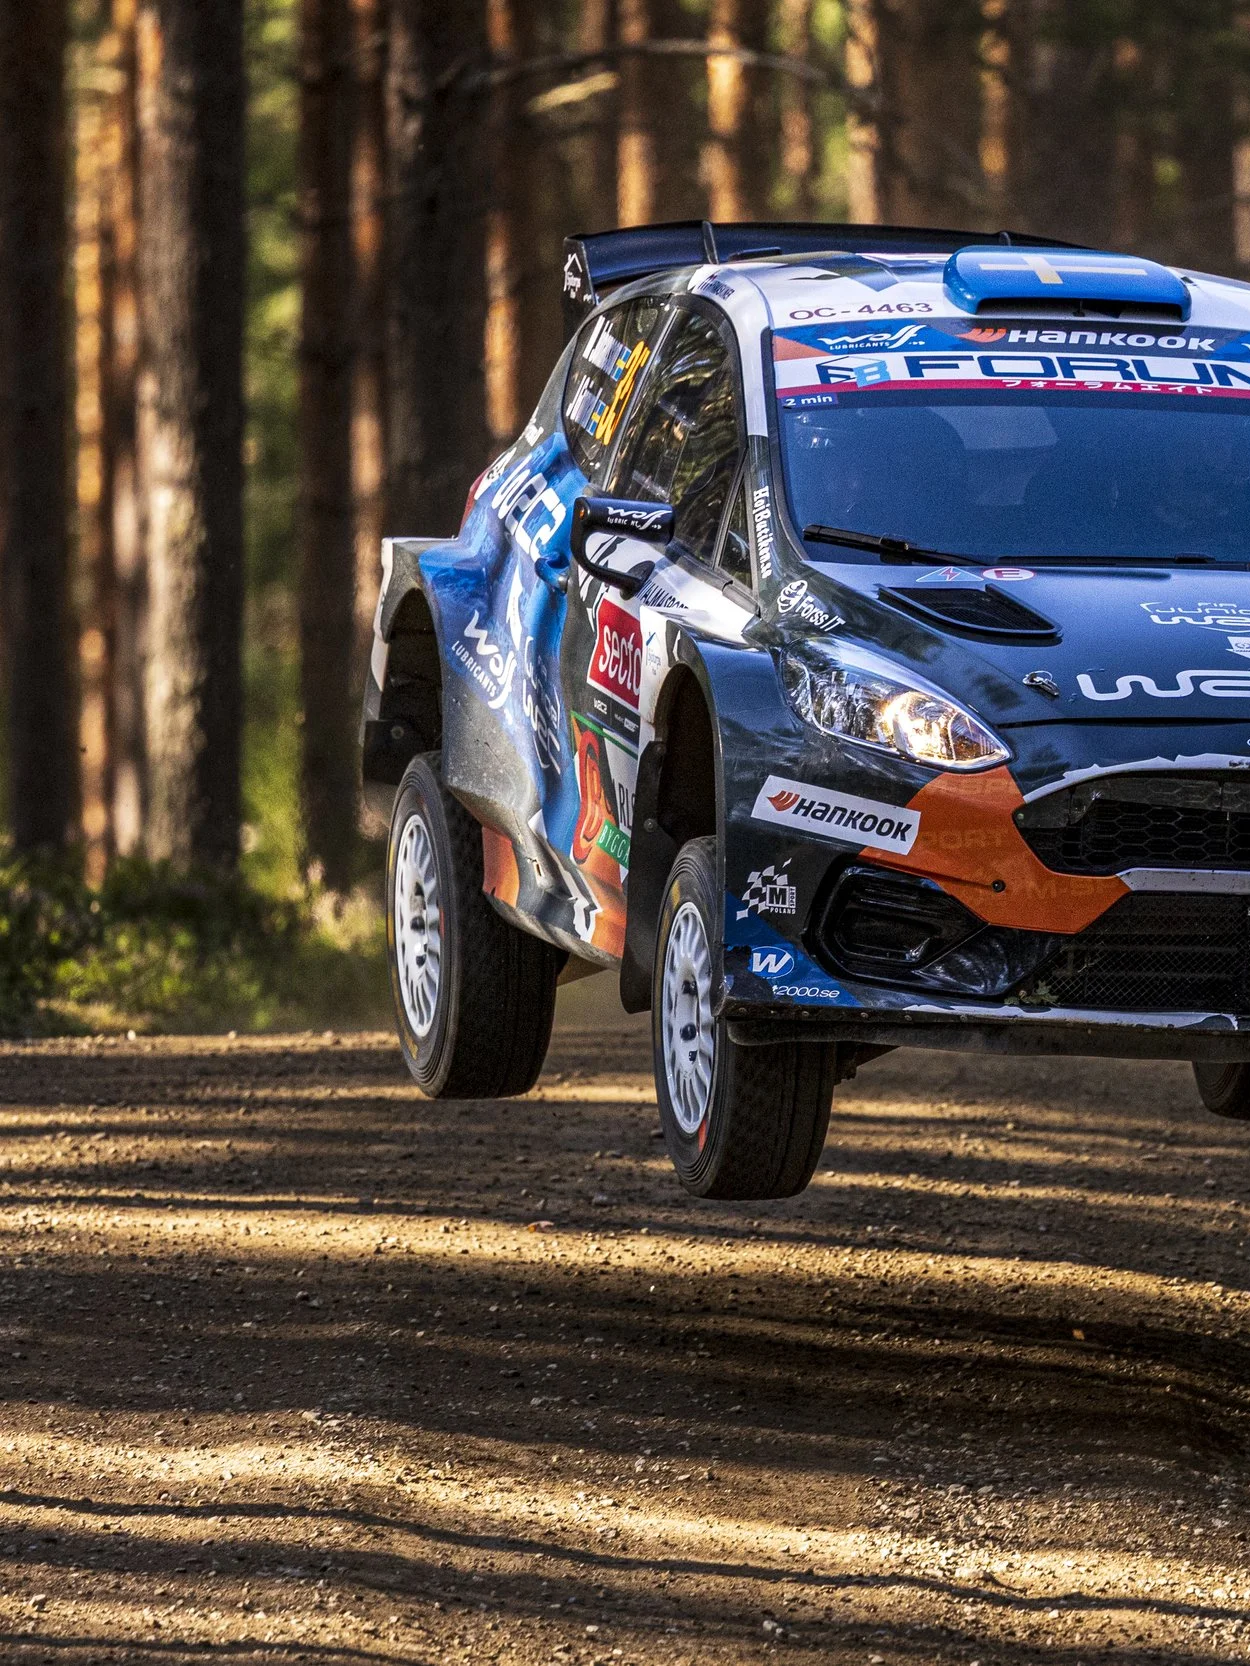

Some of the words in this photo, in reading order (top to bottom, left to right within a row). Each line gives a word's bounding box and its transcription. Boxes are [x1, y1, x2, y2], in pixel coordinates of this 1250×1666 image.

[829, 341, 890, 351] LUBRICANTS
[1001, 378, 1213, 395] フォーラムエイト
[785, 398, 797, 407] 2
[804, 394, 833, 406] min
[451, 640, 498, 698] LUBRICANTS
[752, 952, 792, 973] W
